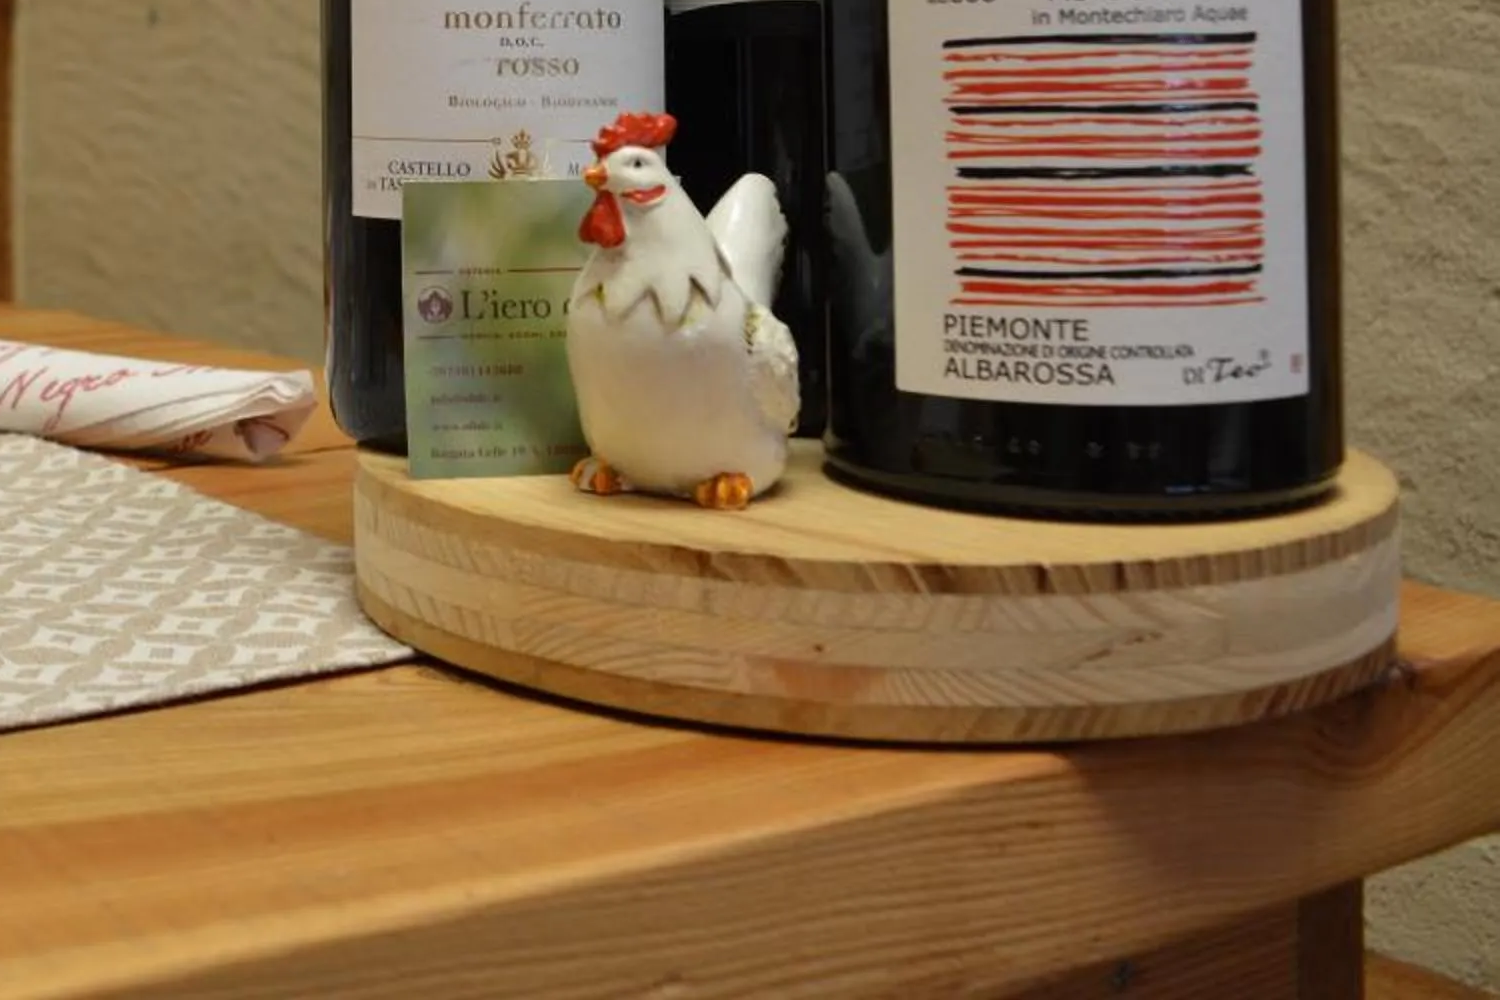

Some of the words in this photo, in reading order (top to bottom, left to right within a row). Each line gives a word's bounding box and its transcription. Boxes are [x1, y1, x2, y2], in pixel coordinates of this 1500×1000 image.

[443, 1, 623, 30] monferrato
[1031, 9, 1050, 25] in
[496, 56, 581, 78] rosso
[388, 159, 471, 178] CASTELLO
[460, 289, 551, 320] L'iero
[943, 313, 1090, 342] PIEMONTE
[943, 356, 1116, 386] ALBAROSSA
